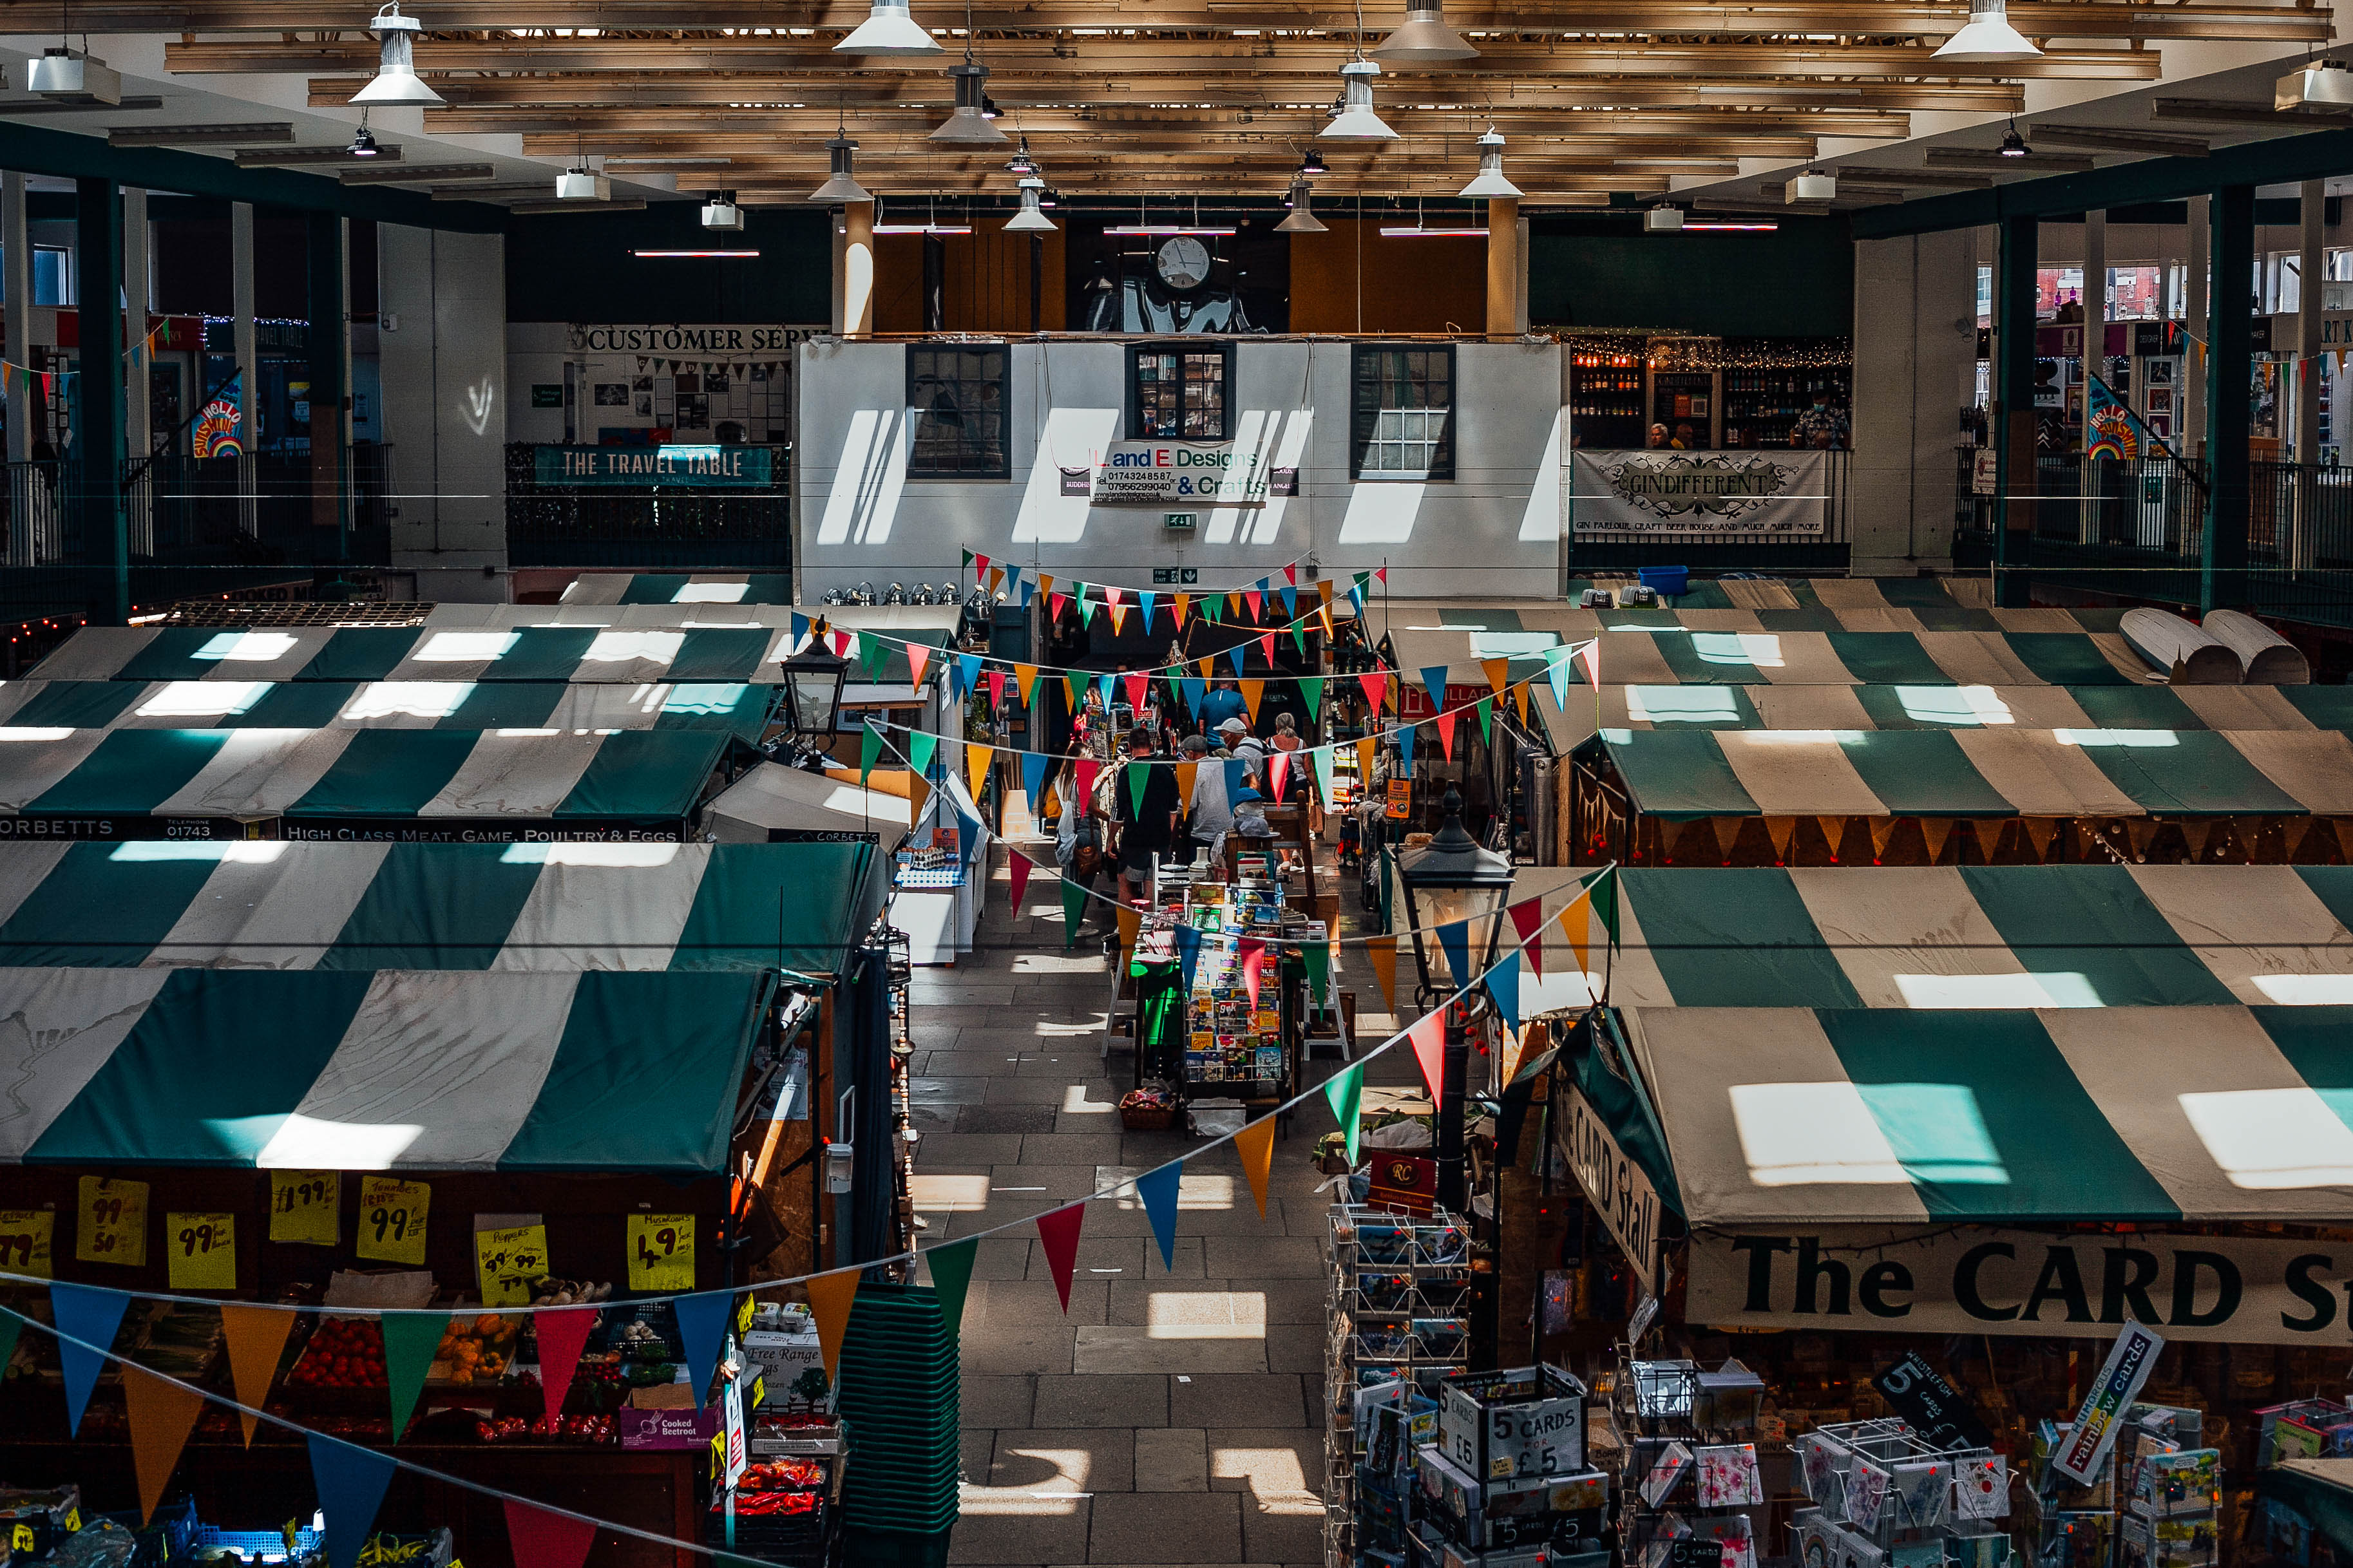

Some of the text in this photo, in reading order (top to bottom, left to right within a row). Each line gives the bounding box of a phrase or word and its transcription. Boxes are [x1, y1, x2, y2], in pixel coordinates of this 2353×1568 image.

[255, 326, 278, 346] RAVEL
[587, 329, 825, 350] CUSTOMER SERV
[563, 452, 743, 477] THE TRAVEL TABLE
[1113, 449, 1151, 468] and
[1156, 449, 1174, 468] E.
[1177, 449, 1257, 471] Designs
[1108, 472, 1171, 480] 01743248587
[1177, 476, 1266, 495] & Crafts
[1629, 474, 1769, 494] GINDIFFERENT
[1576, 521, 1590, 530] GIN
[1634, 522, 1662, 531] CRAFT
[1666, 523, 1686, 531] BEER
[1689, 523, 1715, 531] HOUSE
[1719, 522, 1738, 531] AND
[1742, 523, 1765, 531] MUCH
[1769, 523, 1793, 531] MUCH
[1797, 522, 1821, 531] MORE
[1444, 688, 1491, 702] ILLAR
[167, 826, 211, 836] 01743
[287, 827, 331, 840] HIGH
[337, 828, 395, 842] CLASS
[524, 829, 607, 842] POULTRY
[610, 831, 624, 842] &
[628, 830, 677, 842] EGGS
[1392, 1164, 1413, 1182] RC
[1576, 1105, 1614, 1213] CARD
[1616, 1160, 1653, 1274] Stall
[370, 1208, 408, 1243] 99
[93, 1232, 115, 1252] 50
[178, 1224, 213, 1257] 99
[638, 1227, 676, 1270] 49
[1731, 1236, 1914, 1318] The
[1952, 1242, 2243, 1327] CARD
[748, 1348, 819, 1362] Free Range
[1881, 1361, 1925, 1394] 5
[1906, 1350, 1954, 1398] WHISTLEFISH
[1440, 1385, 1474, 1425] 5 CARDS
[1919, 1391, 1943, 1416] CARDS
[2071, 1366, 2112, 1434] HUMOROUS
[2072, 1337, 2148, 1469] rainbow cards
[662, 1419, 692, 1428] Cooked
[1493, 1409, 1576, 1439] 5 CARDS
[1456, 1433, 1472, 1465] £5
[1503, 1524, 1518, 1544] 5
[1521, 1520, 1546, 1531] CARDS
[1675, 1543, 1689, 1562] 5
[1691, 1549, 1719, 1557] CARDS
